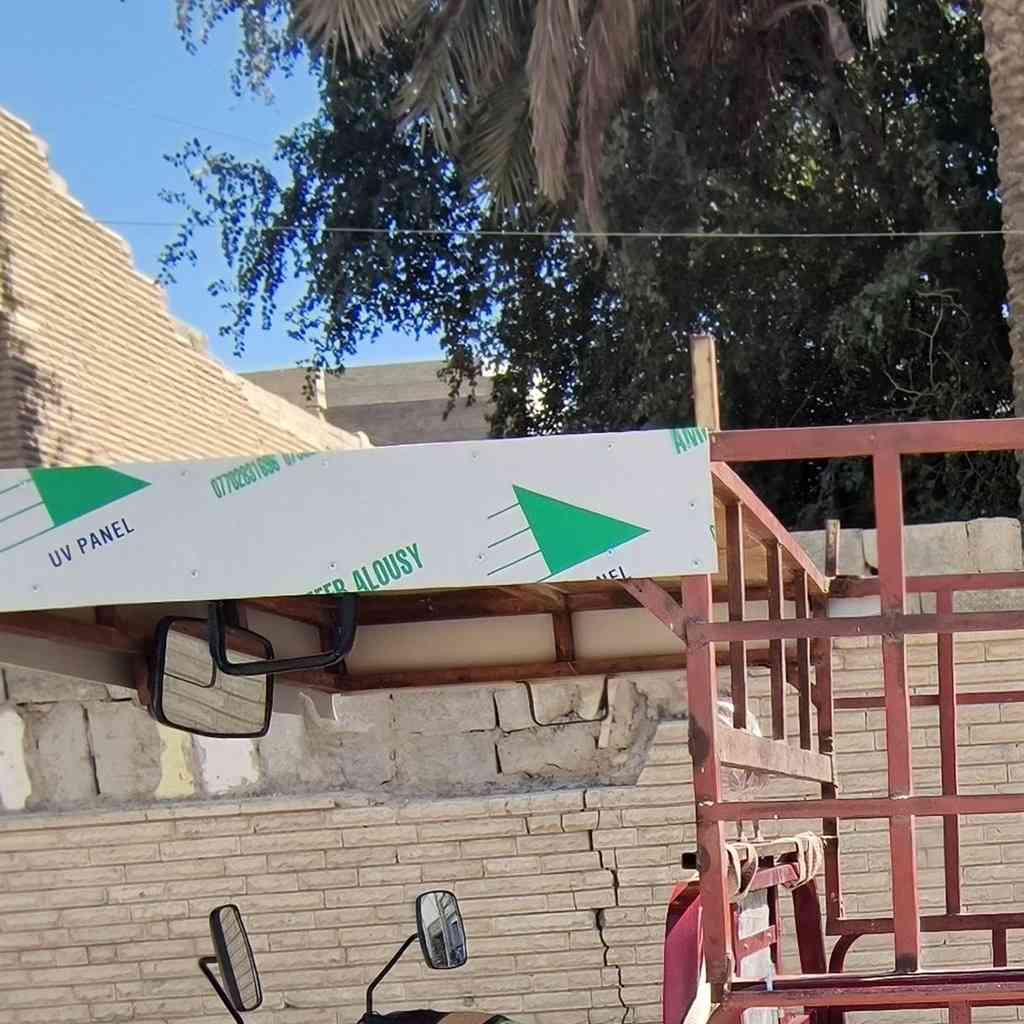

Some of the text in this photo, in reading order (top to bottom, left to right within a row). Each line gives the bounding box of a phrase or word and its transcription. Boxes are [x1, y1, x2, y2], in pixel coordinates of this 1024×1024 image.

[48, 517, 135, 567] UV PANEL
[352, 542, 423, 592] ALOUSY
